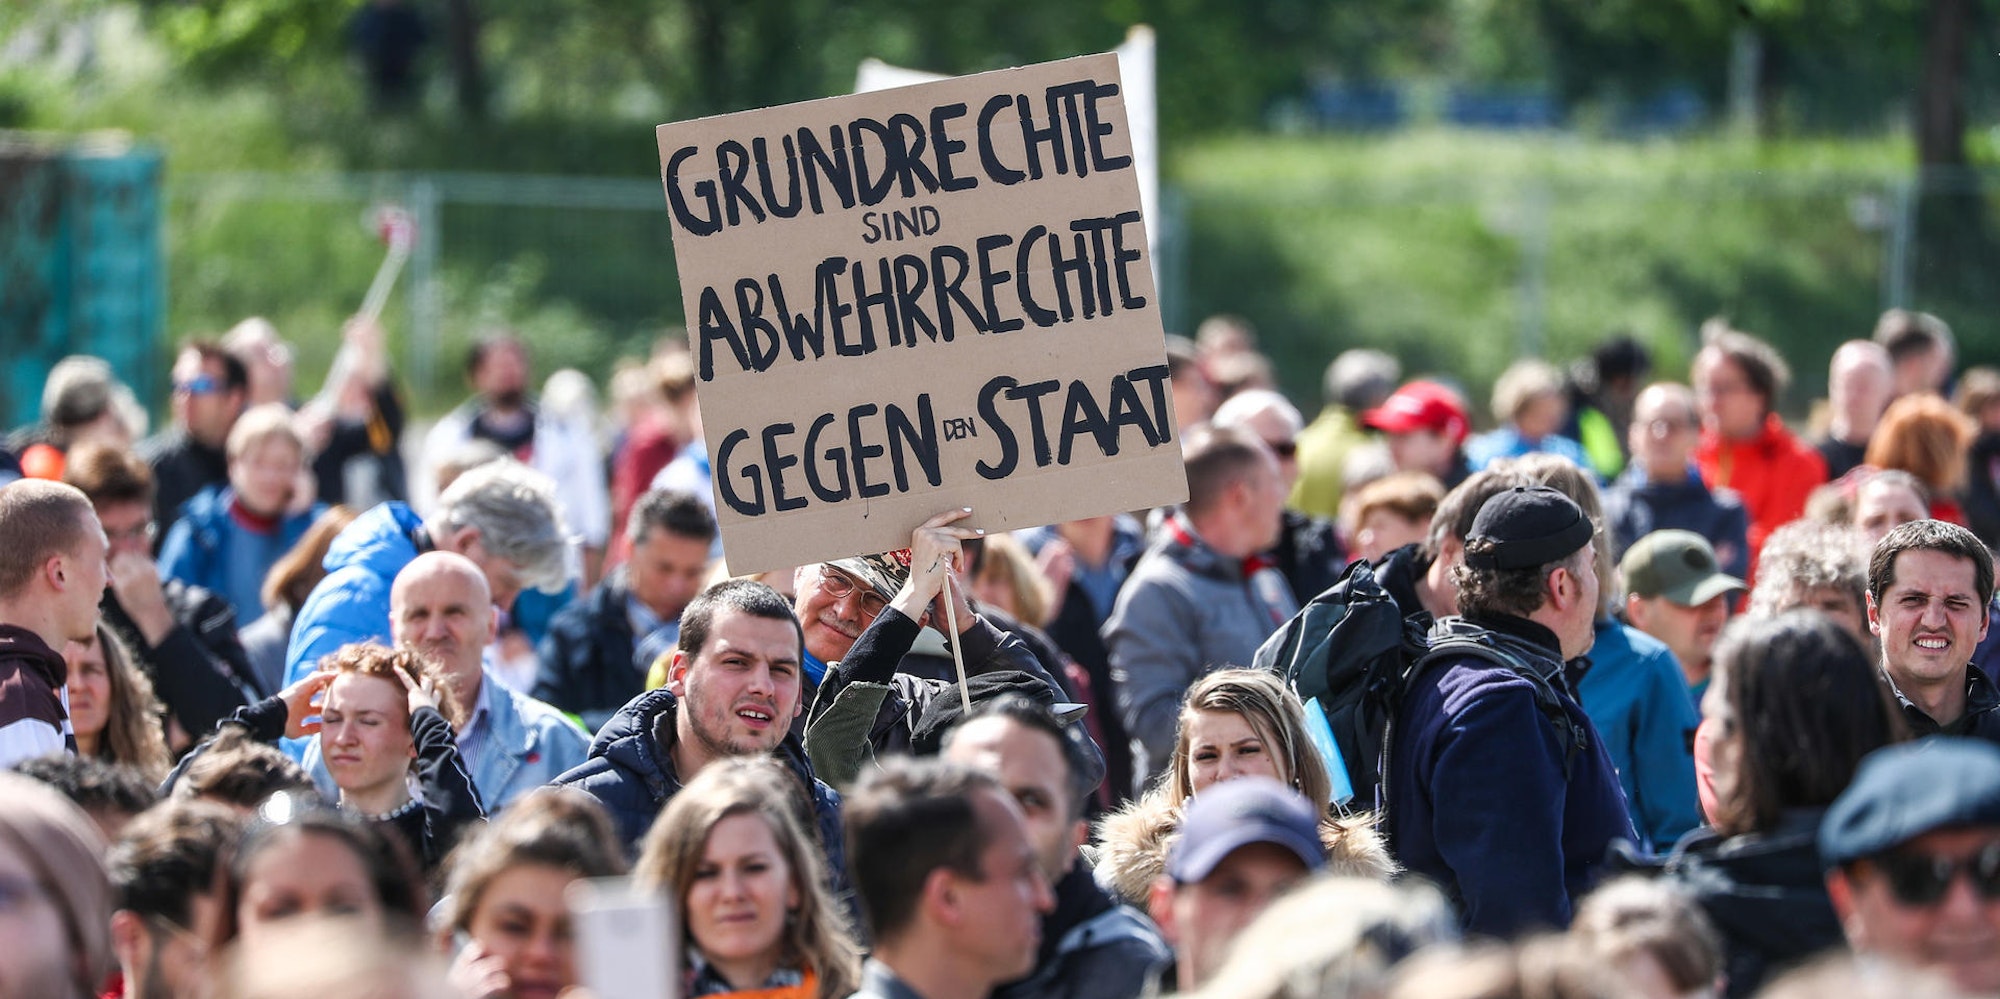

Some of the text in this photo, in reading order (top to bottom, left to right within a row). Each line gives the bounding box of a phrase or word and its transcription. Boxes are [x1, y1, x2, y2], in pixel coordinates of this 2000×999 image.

[667, 80, 1132, 235] GRUNDRECHTE
[862, 205, 941, 243] SIND
[699, 211, 1147, 381] ABWEHRRECHTE
[717, 365, 1172, 515] GEGEN DEN STAAT
